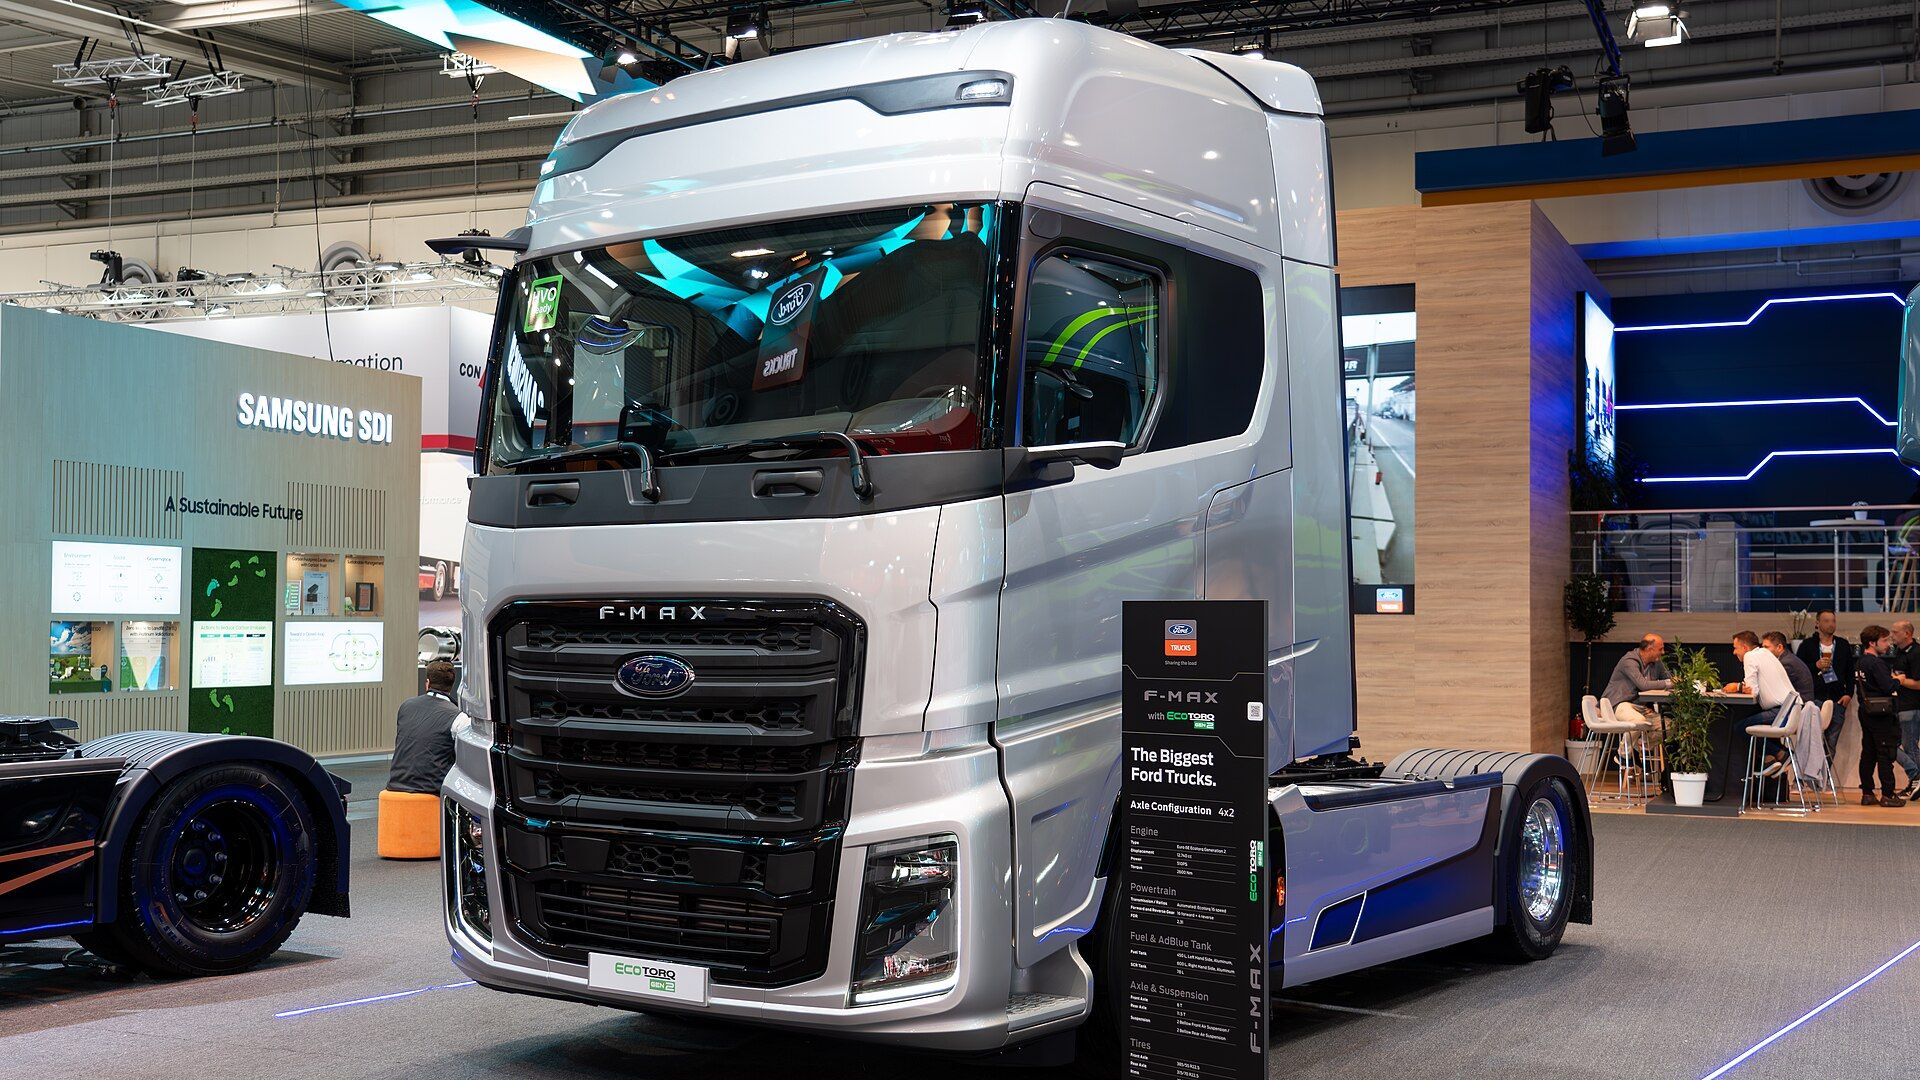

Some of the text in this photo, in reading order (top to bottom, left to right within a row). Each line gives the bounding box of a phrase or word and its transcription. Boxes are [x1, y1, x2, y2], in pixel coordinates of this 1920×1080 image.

[534, 304, 552, 314] eady
[238, 392, 392, 443] SAMSUNG SDI
[165, 496, 304, 520] A Sustainable Future
[1171, 644, 1192, 652] TRUCKS
[1144, 690, 1218, 704] F-MAX
[1148, 712, 1165, 721] with
[1131, 747, 1214, 767] The Biggest
[1131, 767, 1216, 787] Ford Trucks.
[1130, 800, 1235, 818] Axle Configuration 4x2
[1130, 826, 1158, 837] Engine
[1130, 883, 1176, 896] Powertrain
[1130, 932, 1212, 951] Fuel & AdBlue Tank
[1130, 980, 1209, 1001] Axle & Suspension
[1250, 944, 1261, 1054] F-MAX
[1130, 1038, 1151, 1050] Tires
